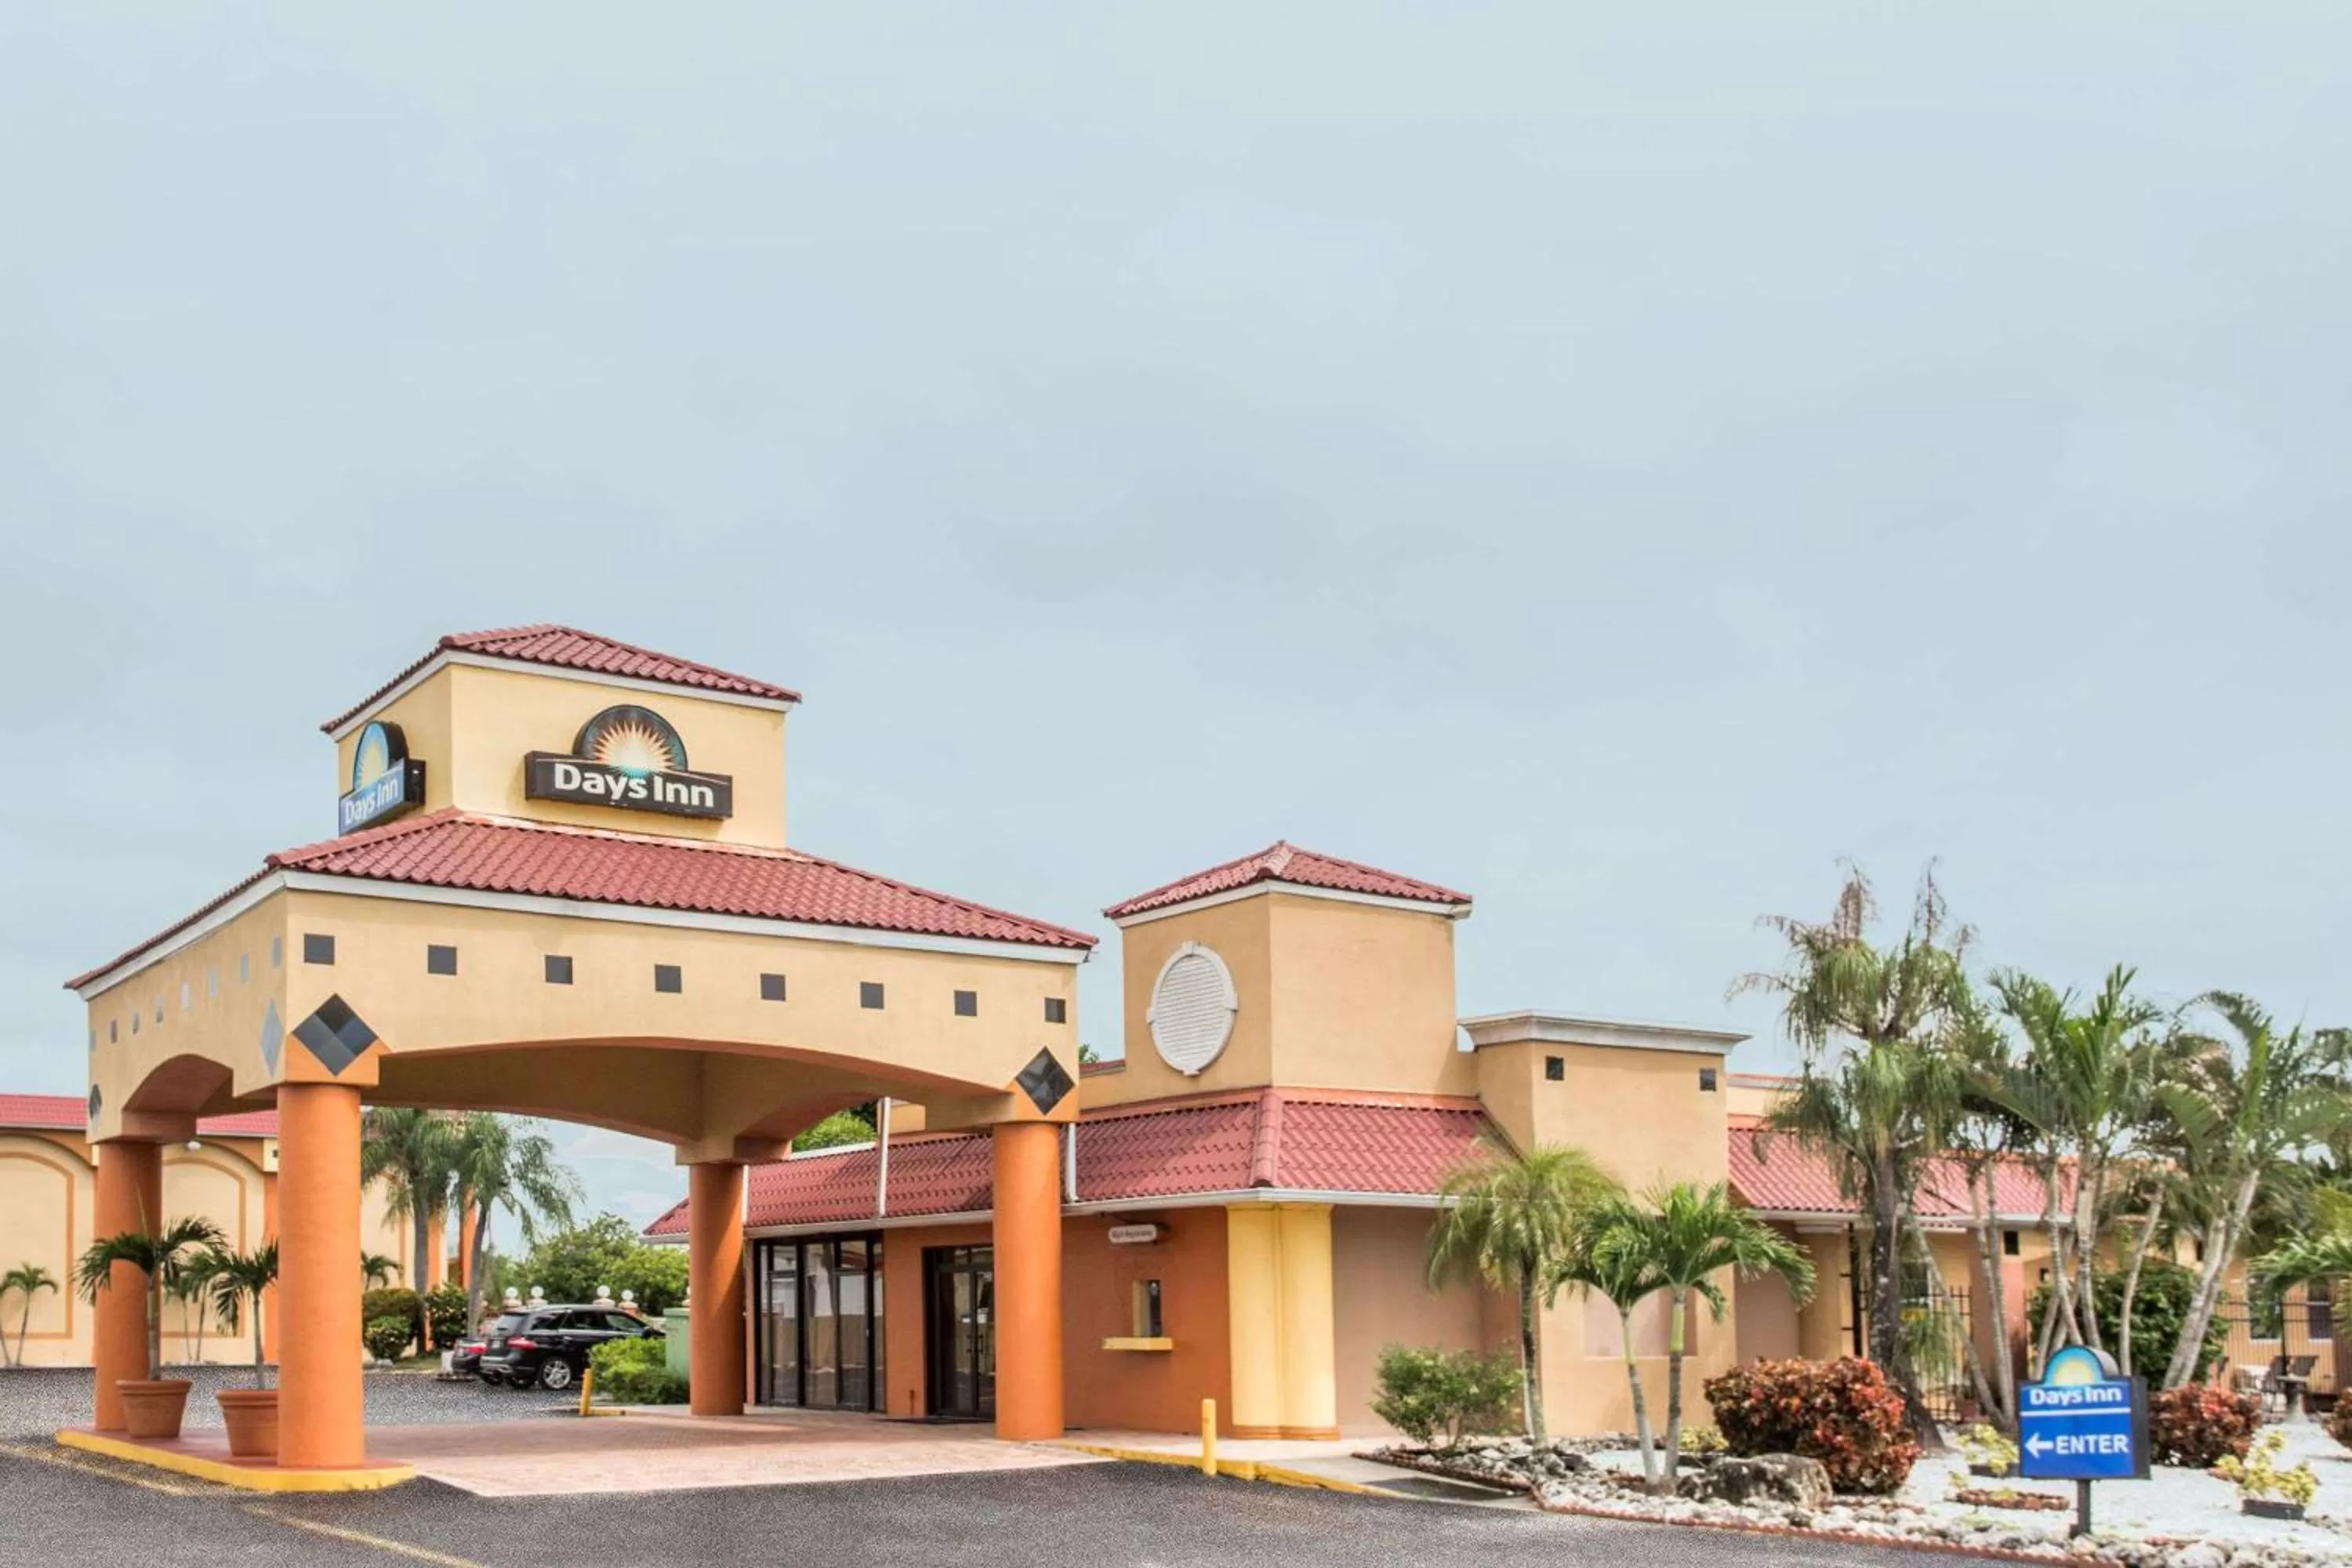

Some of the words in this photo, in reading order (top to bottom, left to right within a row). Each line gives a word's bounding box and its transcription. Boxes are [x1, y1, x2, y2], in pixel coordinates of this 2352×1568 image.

[345, 790, 376, 825] Days
[376, 777, 398, 808] Inn
[555, 764, 648, 800] Days
[654, 775, 714, 808] Inn
[2030, 1387, 2082, 1406] Days
[2085, 1385, 2122, 1403] Inn
[2056, 1434, 2129, 1454] ENTER
